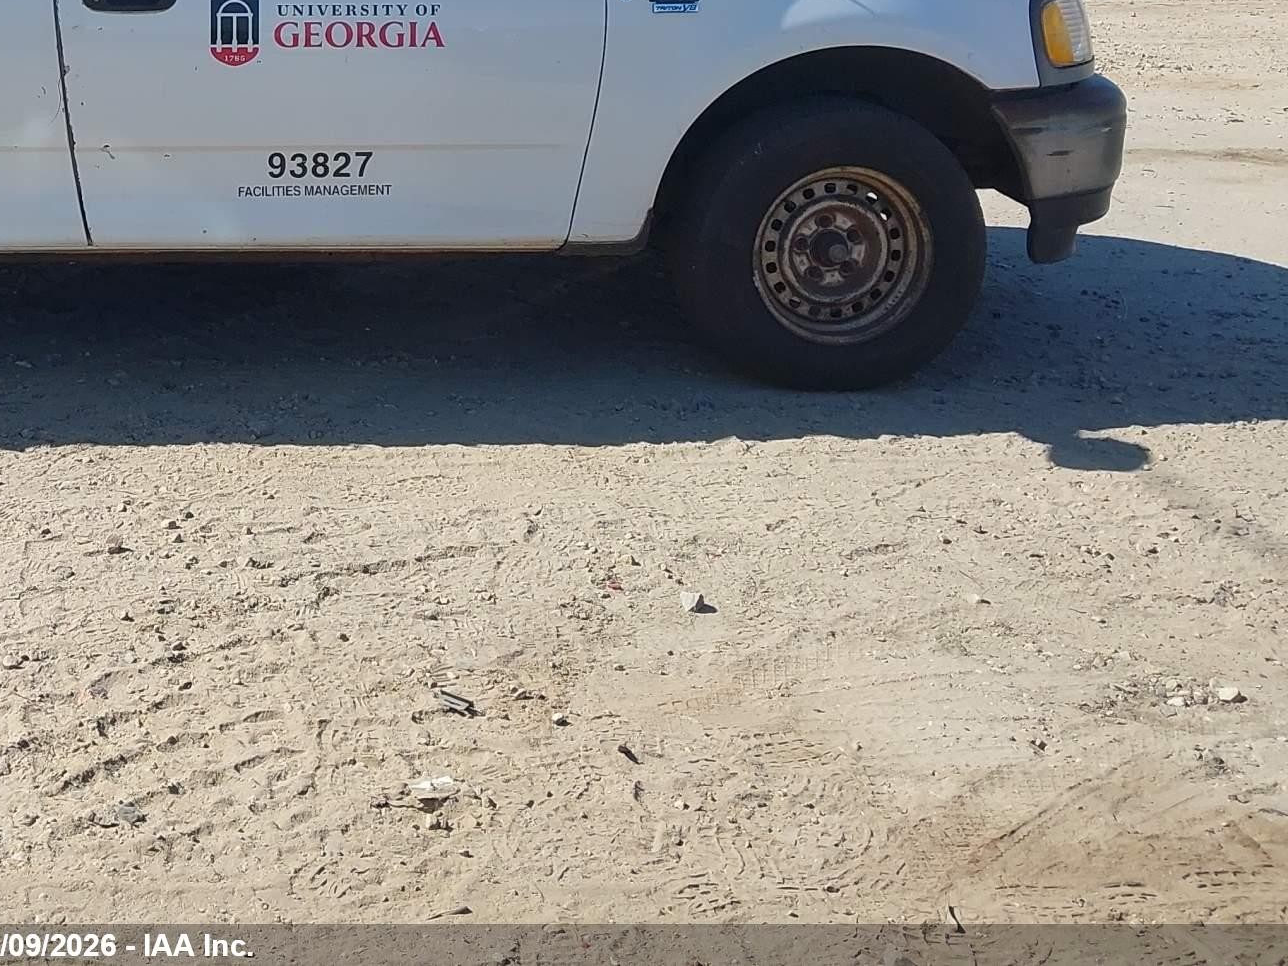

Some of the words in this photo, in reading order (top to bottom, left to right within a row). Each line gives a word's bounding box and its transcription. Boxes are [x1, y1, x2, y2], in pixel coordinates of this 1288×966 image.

[277, 4, 408, 17] UNIVERSITY
[415, 4, 441, 16] OF
[274, 21, 445, 48] GEORGIA
[268, 152, 373, 178] 93827
[238, 186, 301, 197] FACILITIES
[304, 185, 392, 196] MANAGEMENT
